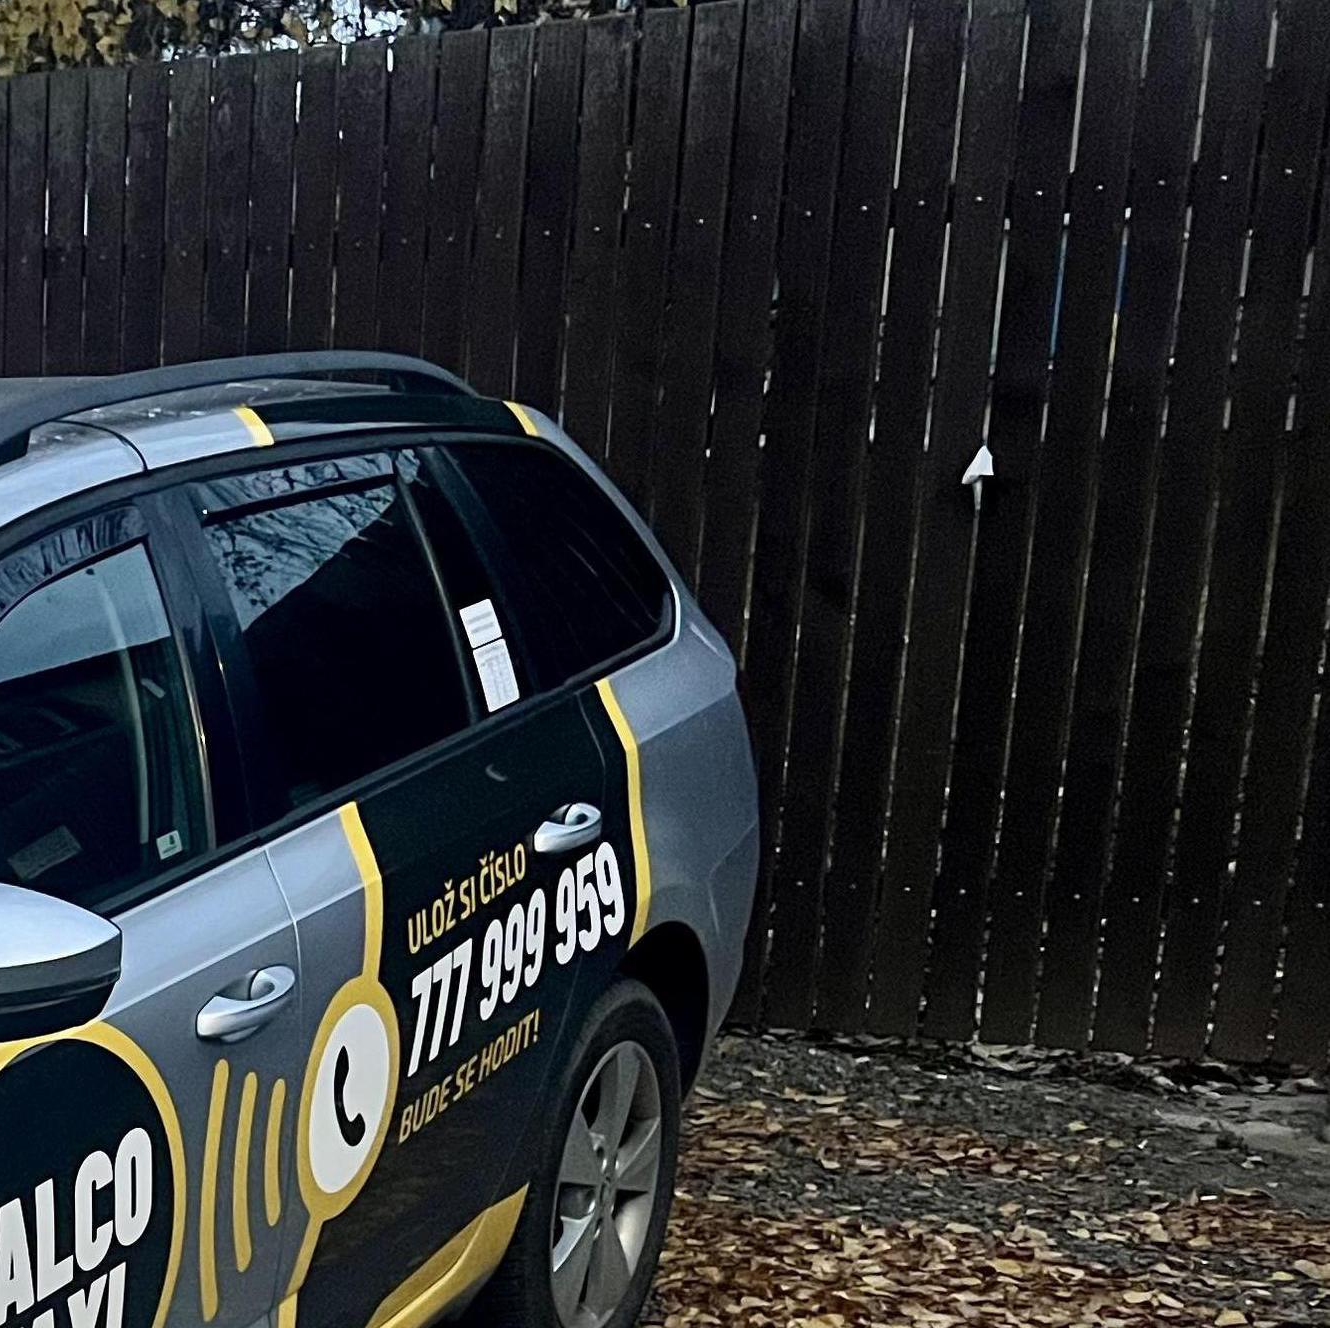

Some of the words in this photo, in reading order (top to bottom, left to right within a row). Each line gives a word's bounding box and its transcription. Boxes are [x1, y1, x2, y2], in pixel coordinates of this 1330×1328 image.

[406, 938, 473, 1077] 777
[479, 888, 546, 1022] 999
[555, 841, 626, 965] 959
[407, 878, 457, 954] ULOŽ
[459, 875, 476, 920] SI
[479, 843, 526, 905] ČÍSLO
[398, 1075, 451, 1145] BUDE
[451, 1054, 478, 1100] SE
[478, 1008, 540, 1082] HODIT!
